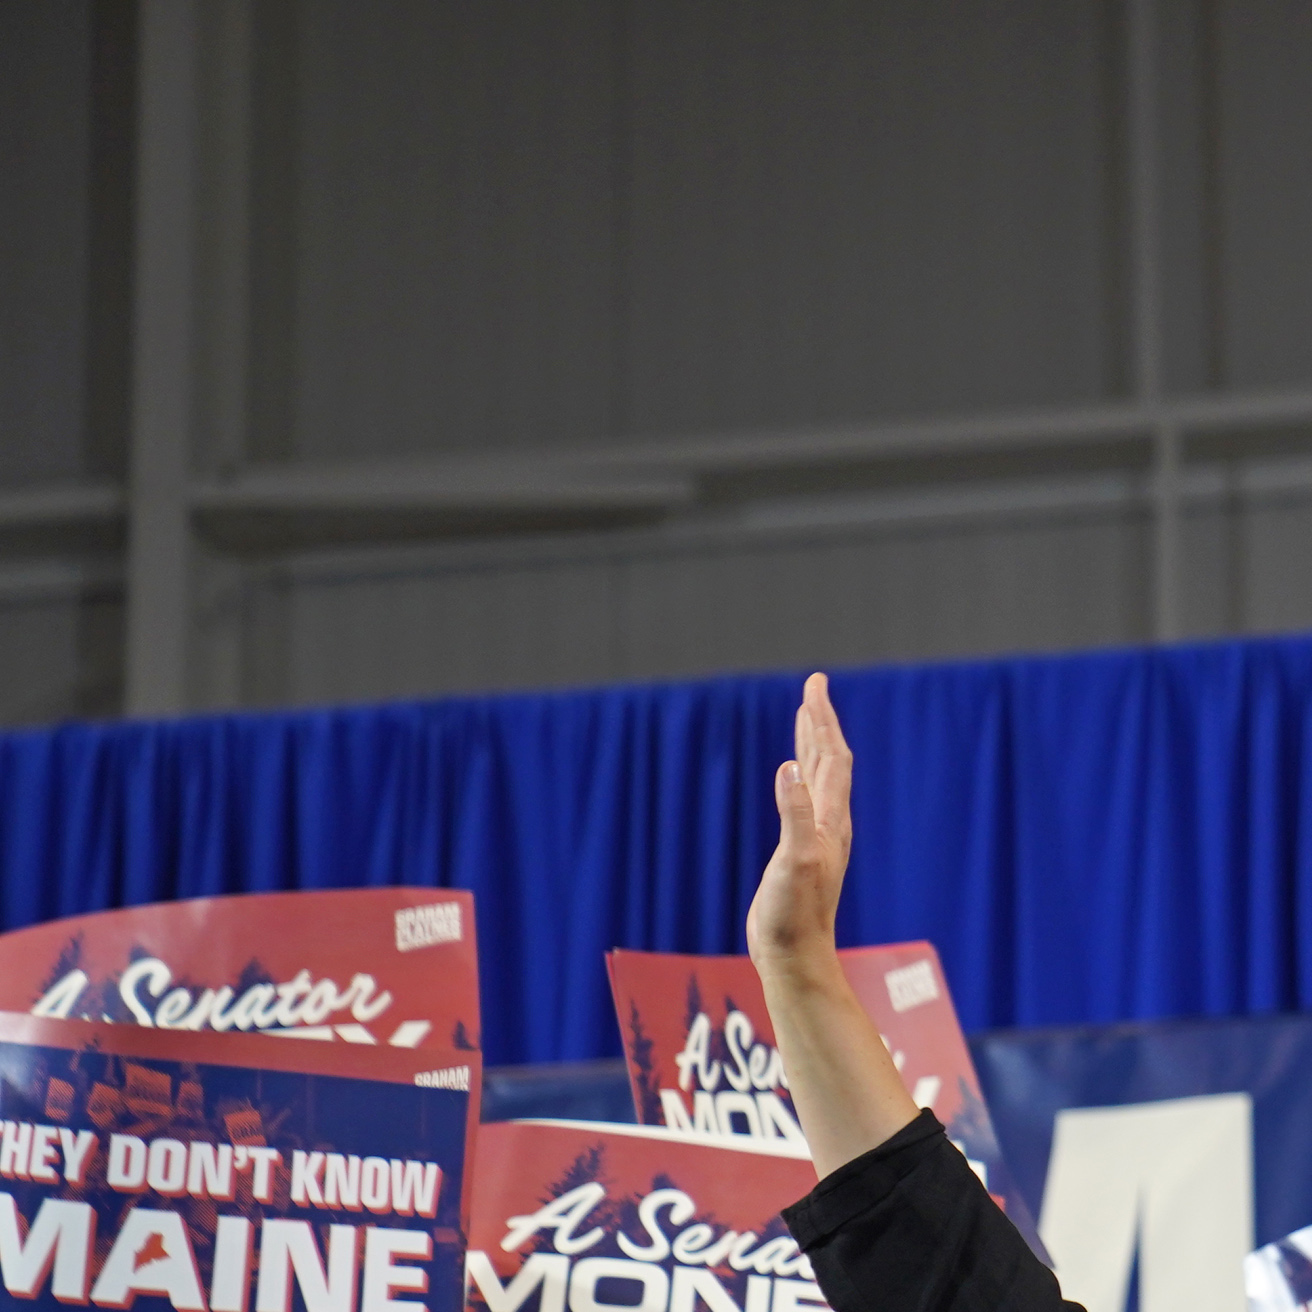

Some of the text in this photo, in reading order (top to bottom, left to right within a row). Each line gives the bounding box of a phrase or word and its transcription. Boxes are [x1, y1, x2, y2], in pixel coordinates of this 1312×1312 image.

[112, 957, 393, 1031] Senator
[415, 1066, 470, 1089] GRAHAM
[675, 1012, 721, 1092] A
[0, 1120, 440, 1217] HEY DON'T KNOW
[501, 1181, 818, 1281] A Sena
